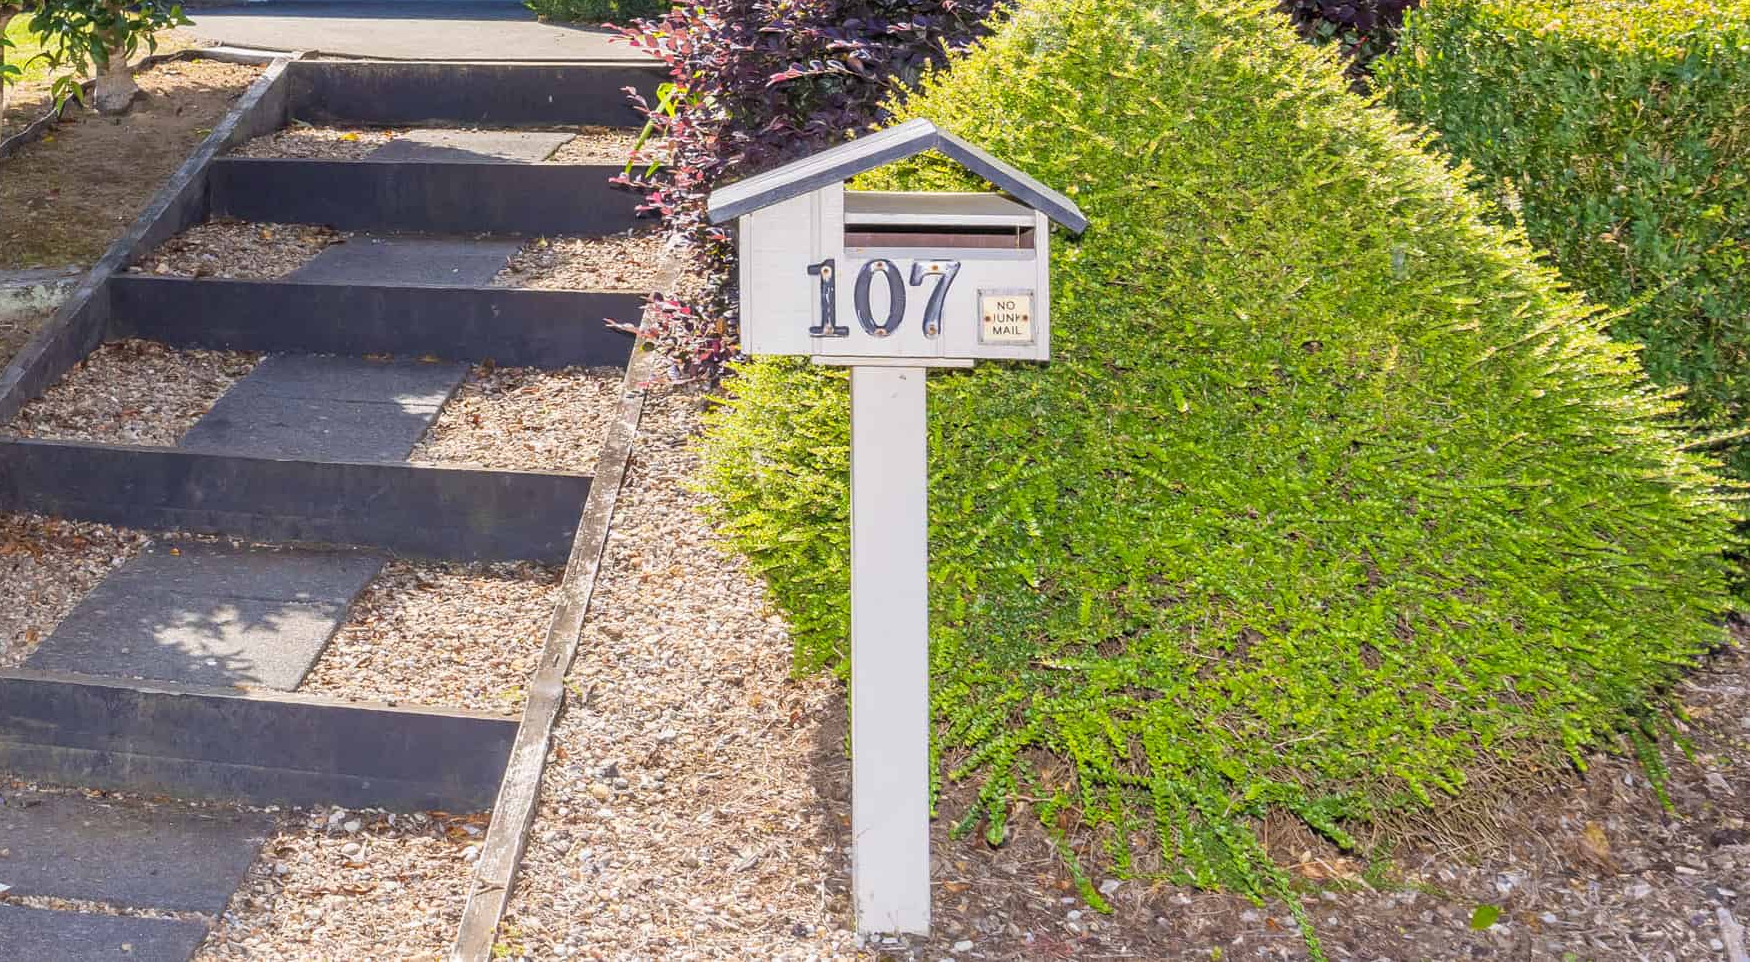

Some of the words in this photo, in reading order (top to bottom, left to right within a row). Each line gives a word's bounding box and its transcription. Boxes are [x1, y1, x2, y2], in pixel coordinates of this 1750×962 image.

[807, 258, 961, 338] 107
[997, 301, 1016, 311] NO
[993, 325, 1023, 335] MAIL
